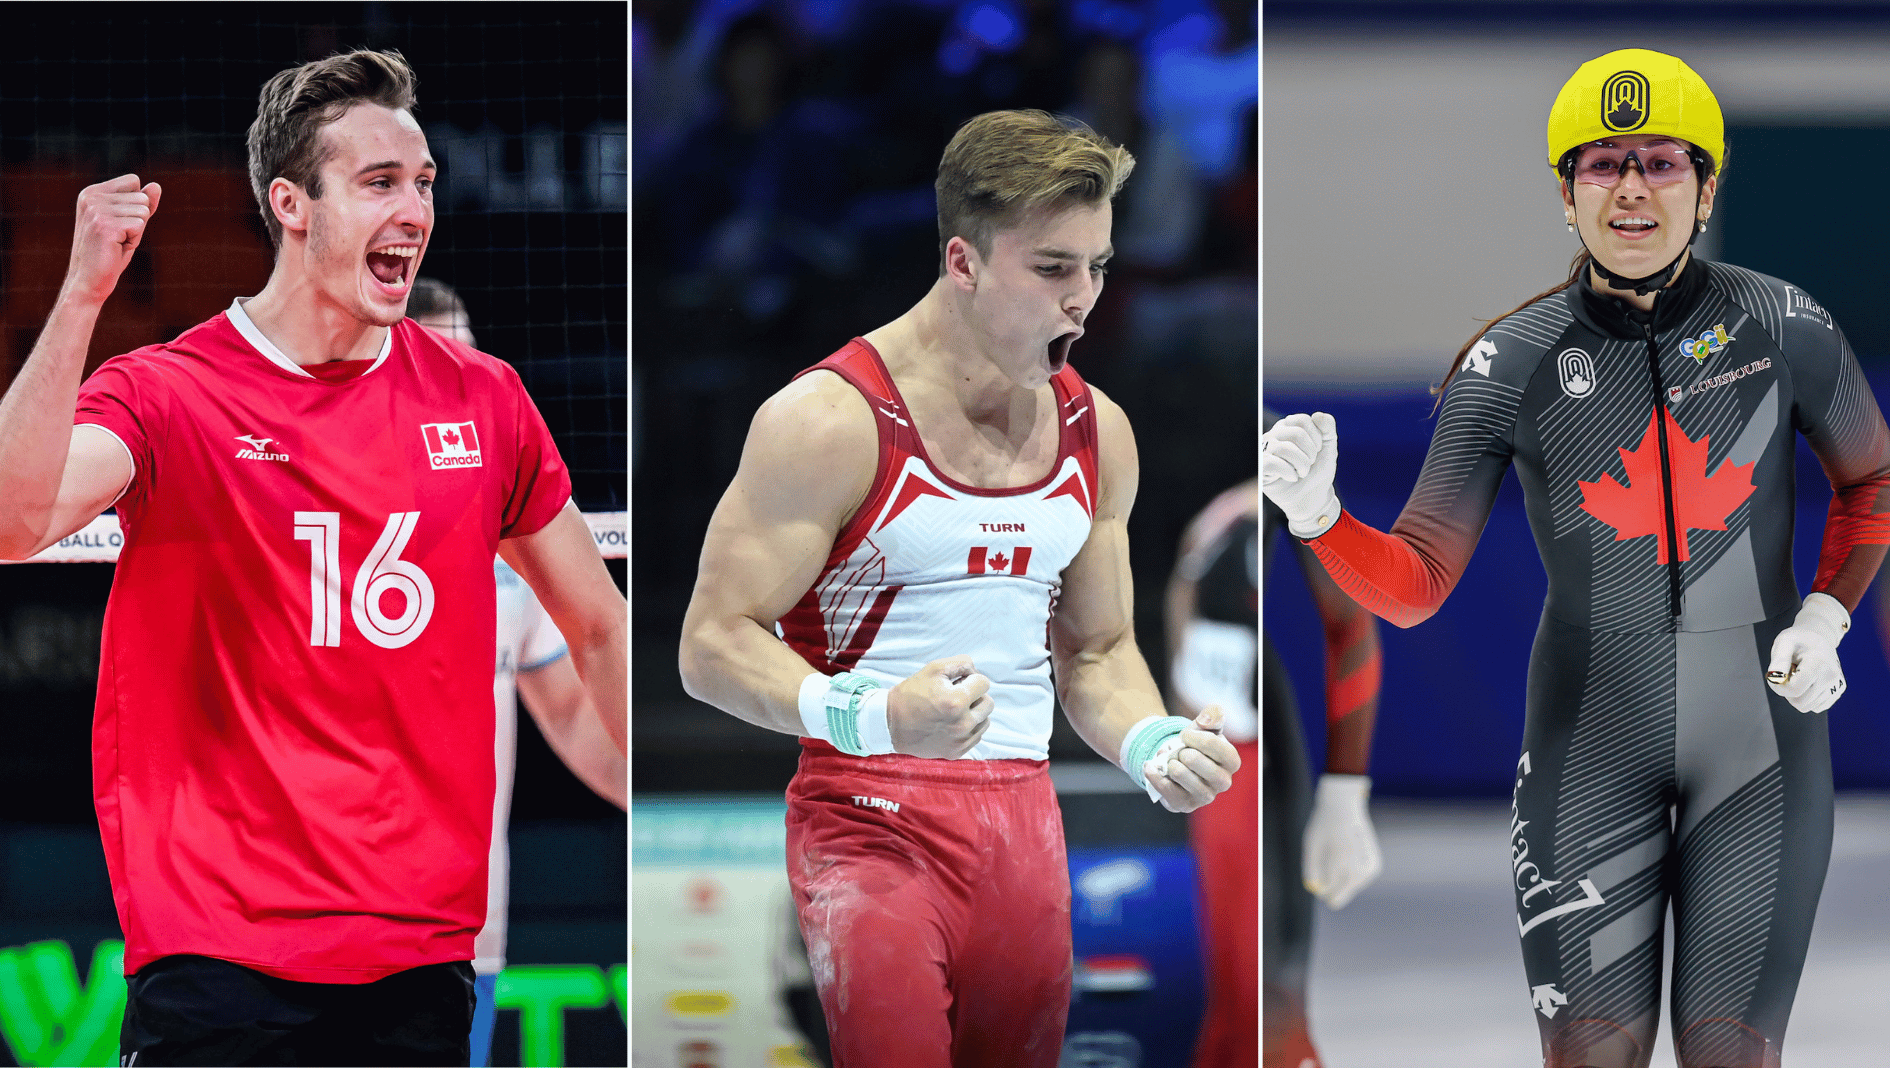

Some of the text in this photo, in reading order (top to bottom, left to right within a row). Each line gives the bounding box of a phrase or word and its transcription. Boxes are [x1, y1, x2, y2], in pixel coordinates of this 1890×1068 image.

[1689, 357, 1772, 395] LOUISBOURG
[432, 453, 480, 467] Canada
[979, 523, 1026, 532] TURN
[294, 511, 435, 649] 16
[851, 795, 900, 813] TURN
